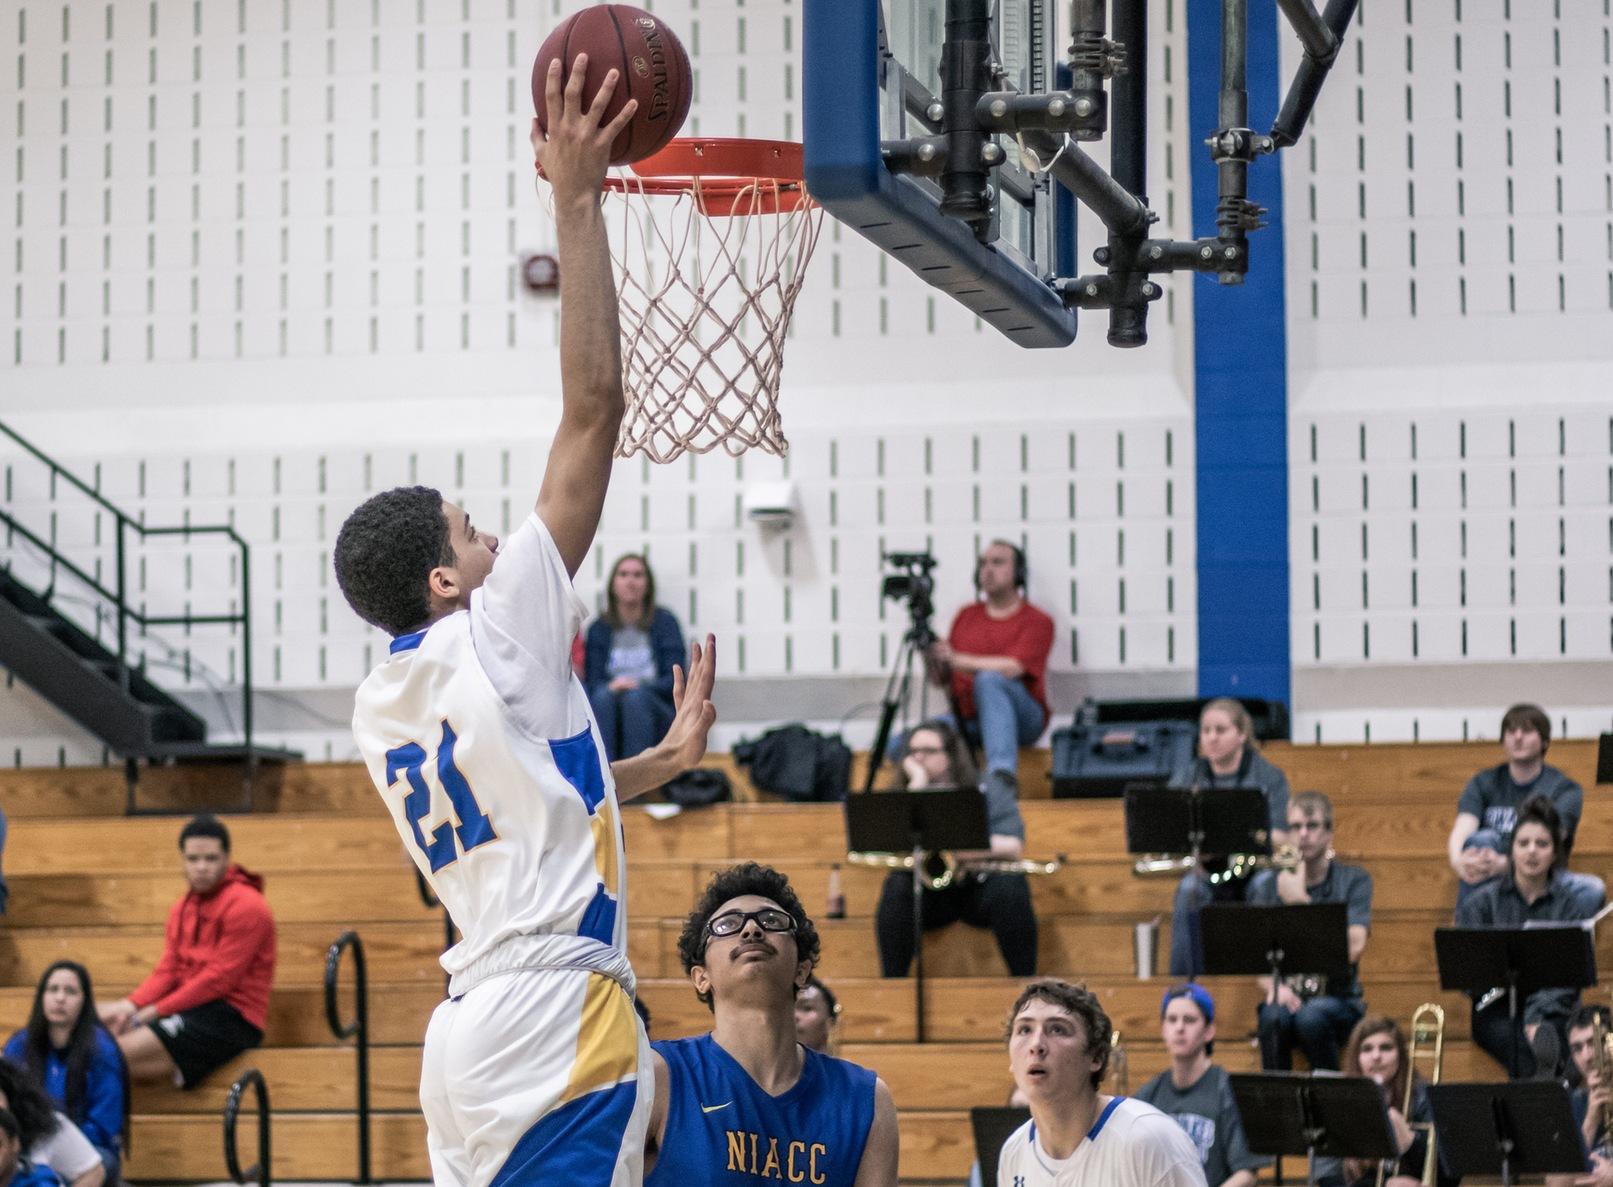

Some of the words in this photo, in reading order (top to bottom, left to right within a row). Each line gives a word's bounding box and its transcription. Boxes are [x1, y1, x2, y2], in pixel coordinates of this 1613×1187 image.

[640, 18, 669, 121] SPALDING
[385, 715, 501, 877] 21
[725, 1130, 827, 1185] NIACC
